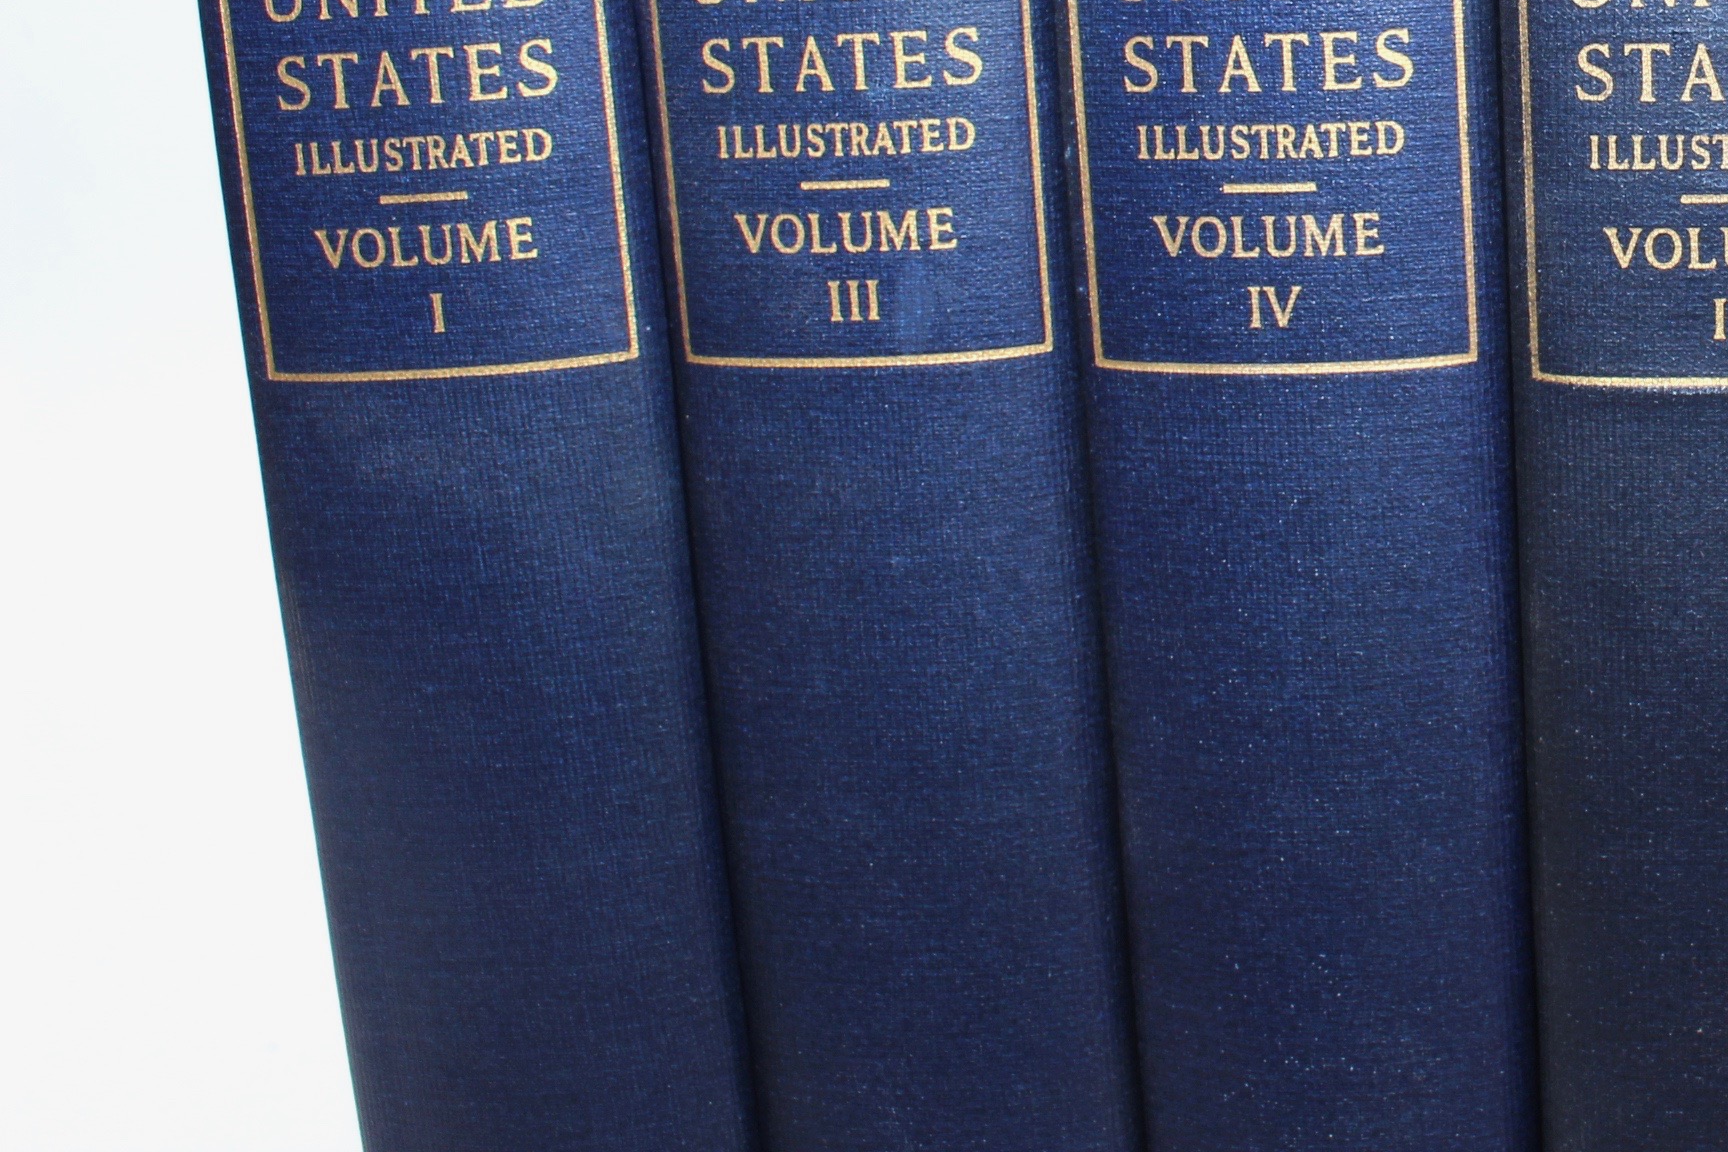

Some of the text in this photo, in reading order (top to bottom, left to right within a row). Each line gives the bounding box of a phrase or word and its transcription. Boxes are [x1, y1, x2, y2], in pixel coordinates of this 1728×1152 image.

[277, 39, 557, 110] STATES
[701, 28, 982, 93] STATES
[1124, 29, 1412, 92] STATES
[295, 129, 551, 176] ILLUSTRATED
[718, 118, 975, 159] ILLUSTRATED
[1138, 121, 1404, 160] ILLUSTRATED
[314, 217, 536, 268] VOLUME
[735, 208, 956, 254] VOLUME
[1153, 213, 1383, 258] VOLUME
[431, 293, 444, 333] I
[827, 280, 879, 322] III
[1248, 287, 1300, 328] IV
